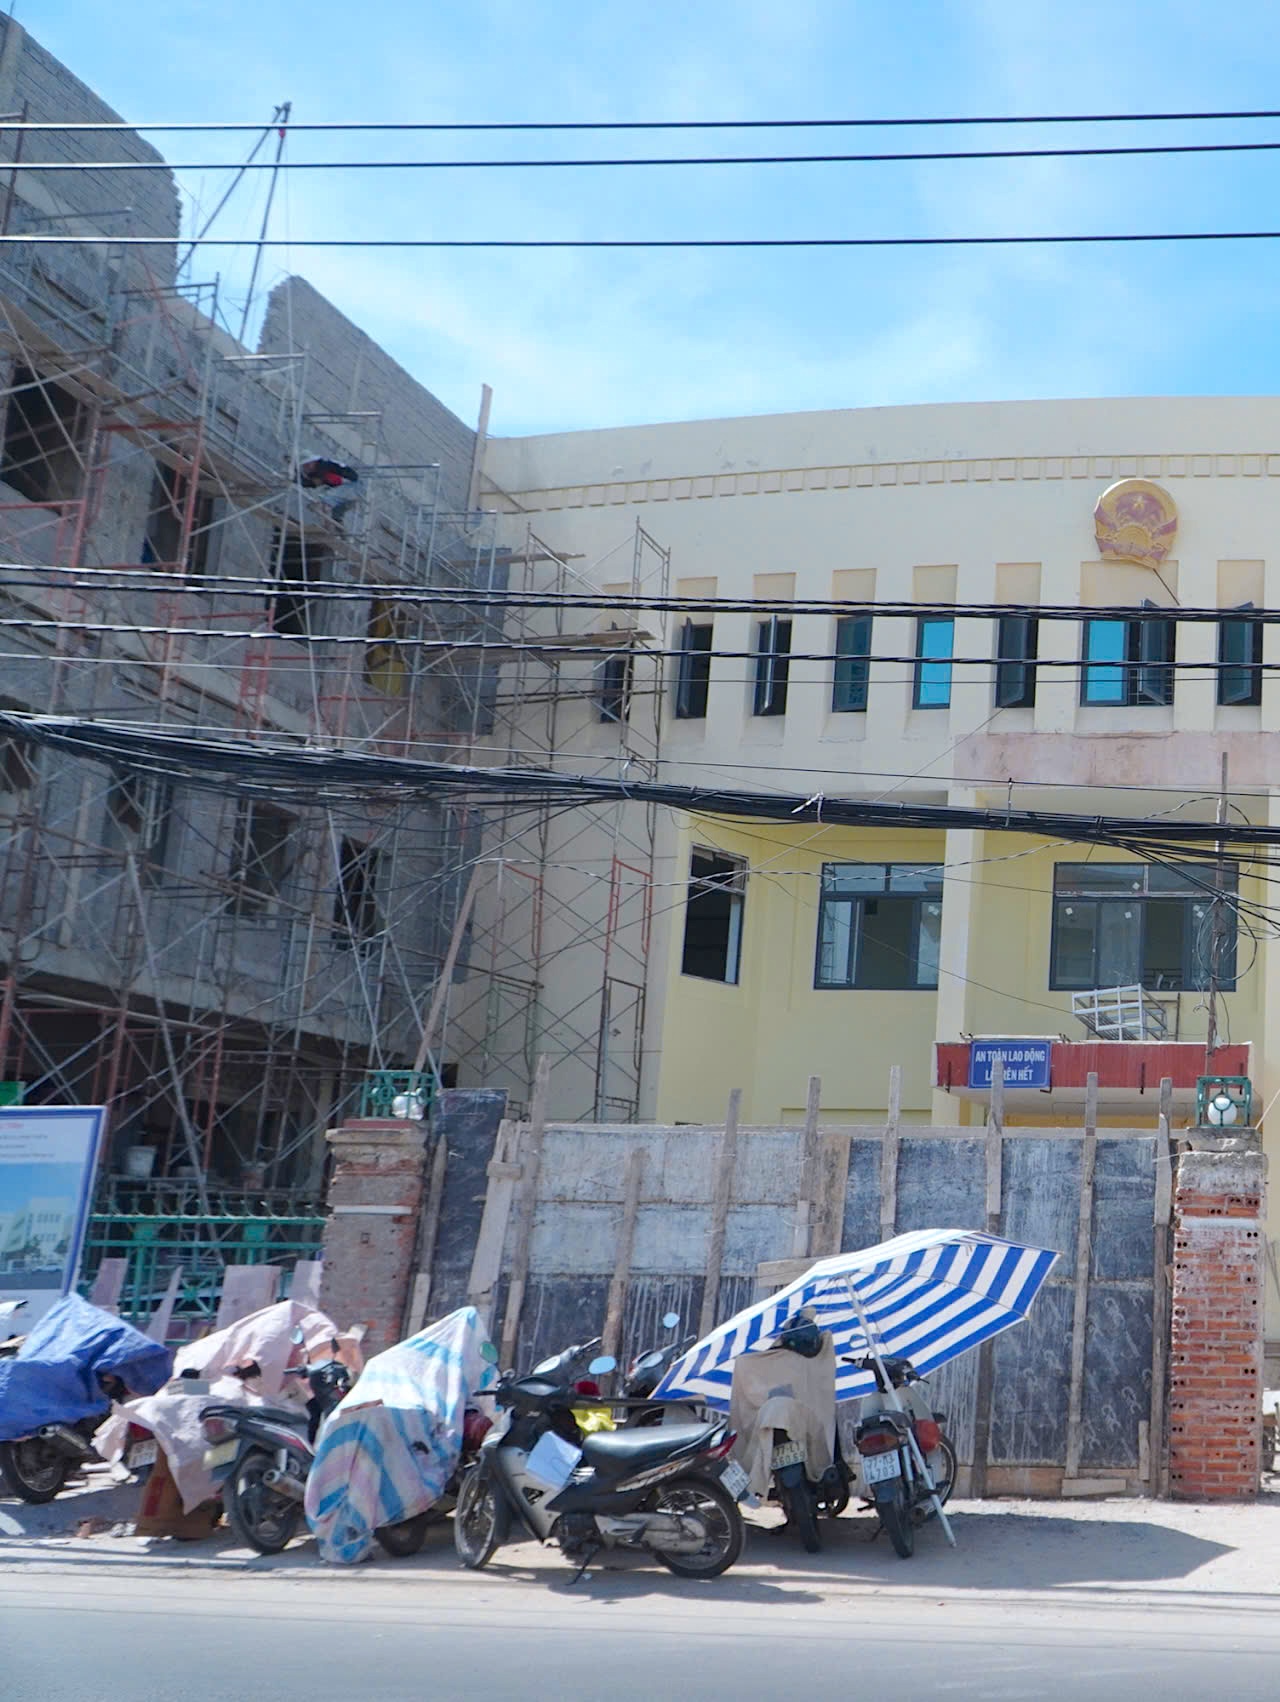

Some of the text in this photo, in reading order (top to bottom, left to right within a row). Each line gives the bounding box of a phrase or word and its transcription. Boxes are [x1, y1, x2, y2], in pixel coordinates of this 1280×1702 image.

[975, 1047, 1045, 1065] AN TOÀN LAO ĐỘNG
[1018, 1064, 1034, 1081] HẾT
